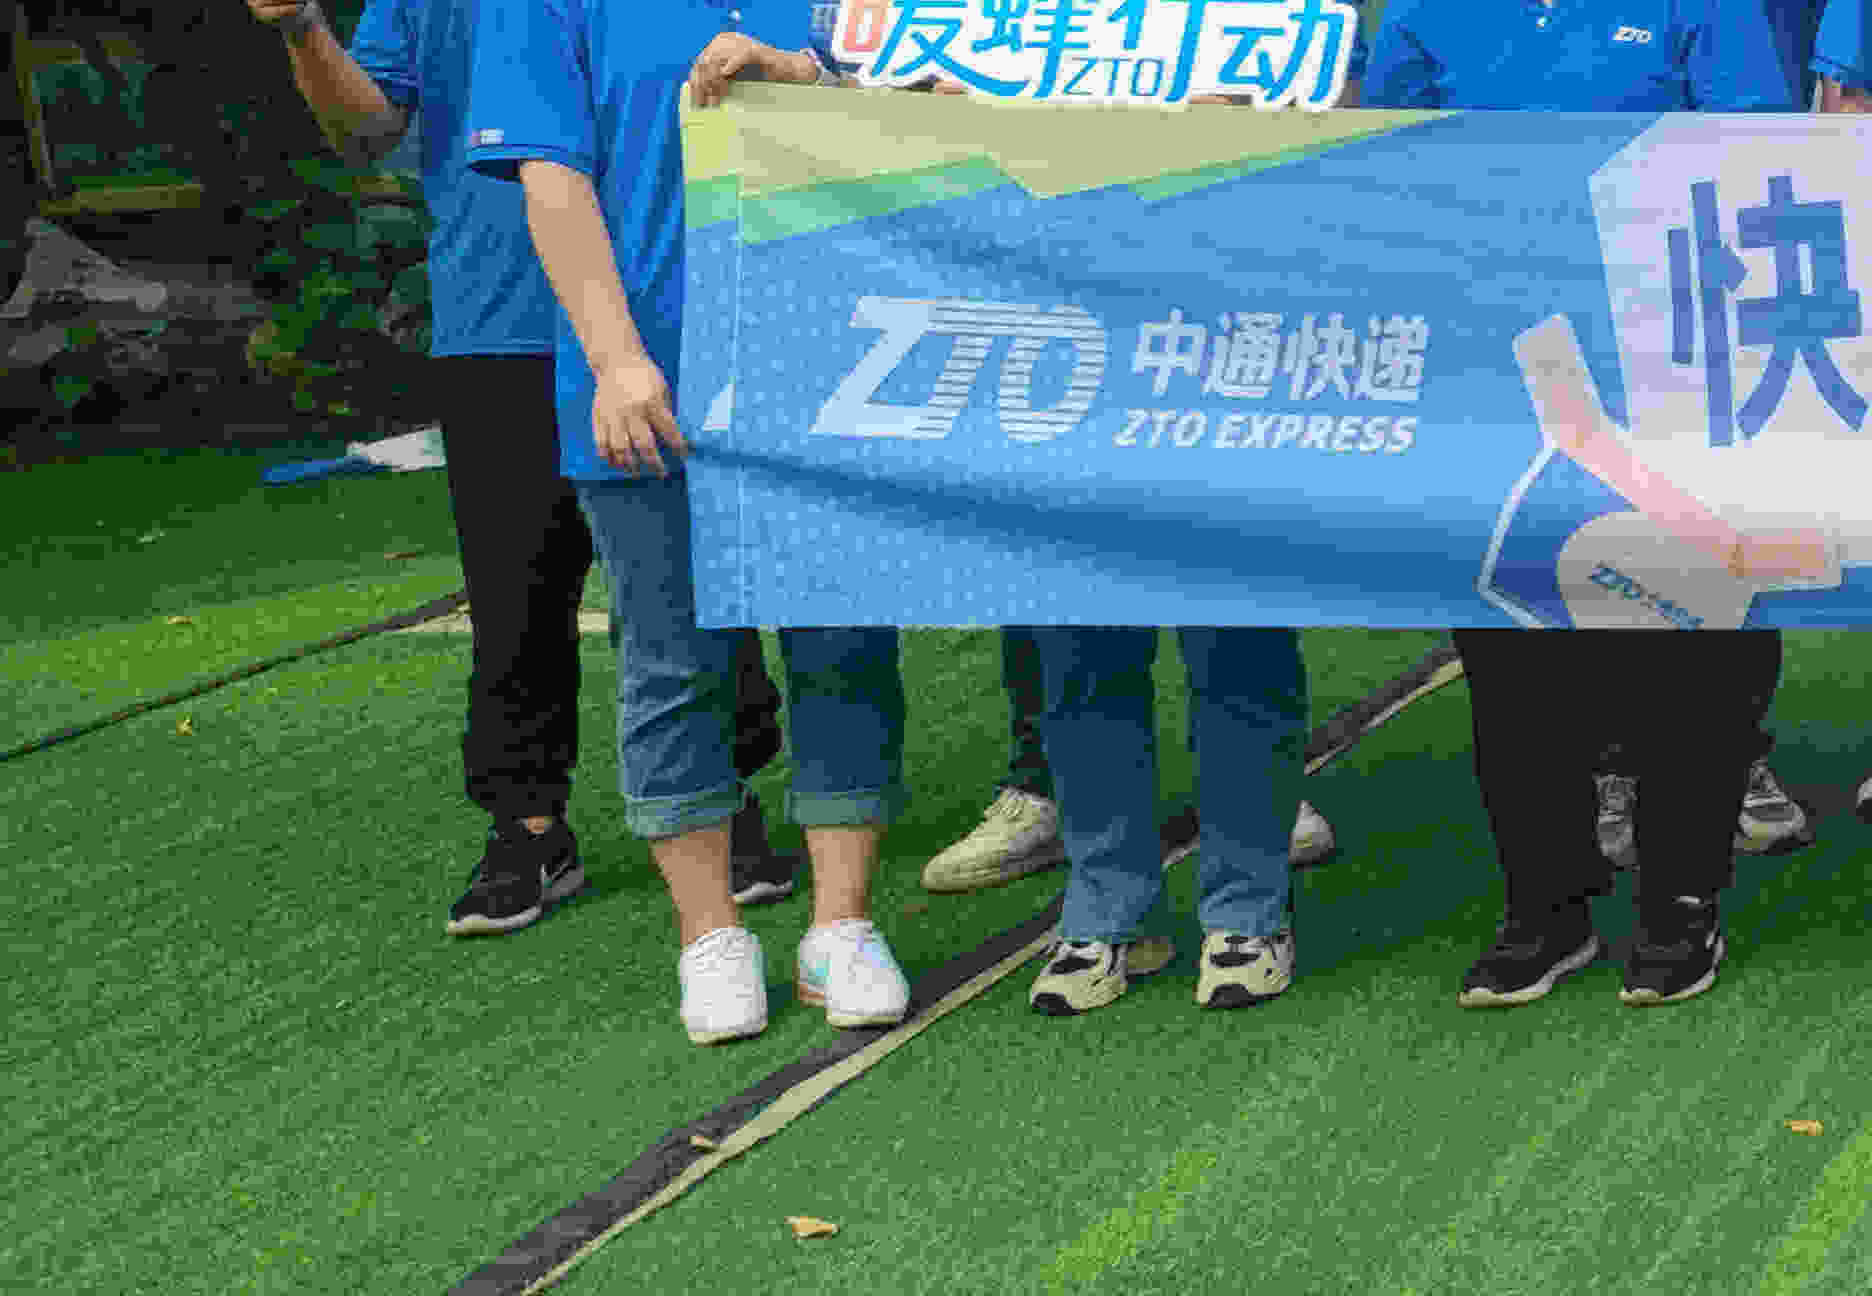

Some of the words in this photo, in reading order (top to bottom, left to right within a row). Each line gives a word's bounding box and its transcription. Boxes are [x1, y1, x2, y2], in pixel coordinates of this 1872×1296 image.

[1612, 24, 1652, 44] ZTO
[1063, 57, 1165, 97] ZTO
[807, 295, 1107, 444] ZTO
[1130, 307, 1429, 402] 中通快递
[1113, 408, 1207, 448] ZTO
[1214, 411, 1420, 455] EXPRESS
